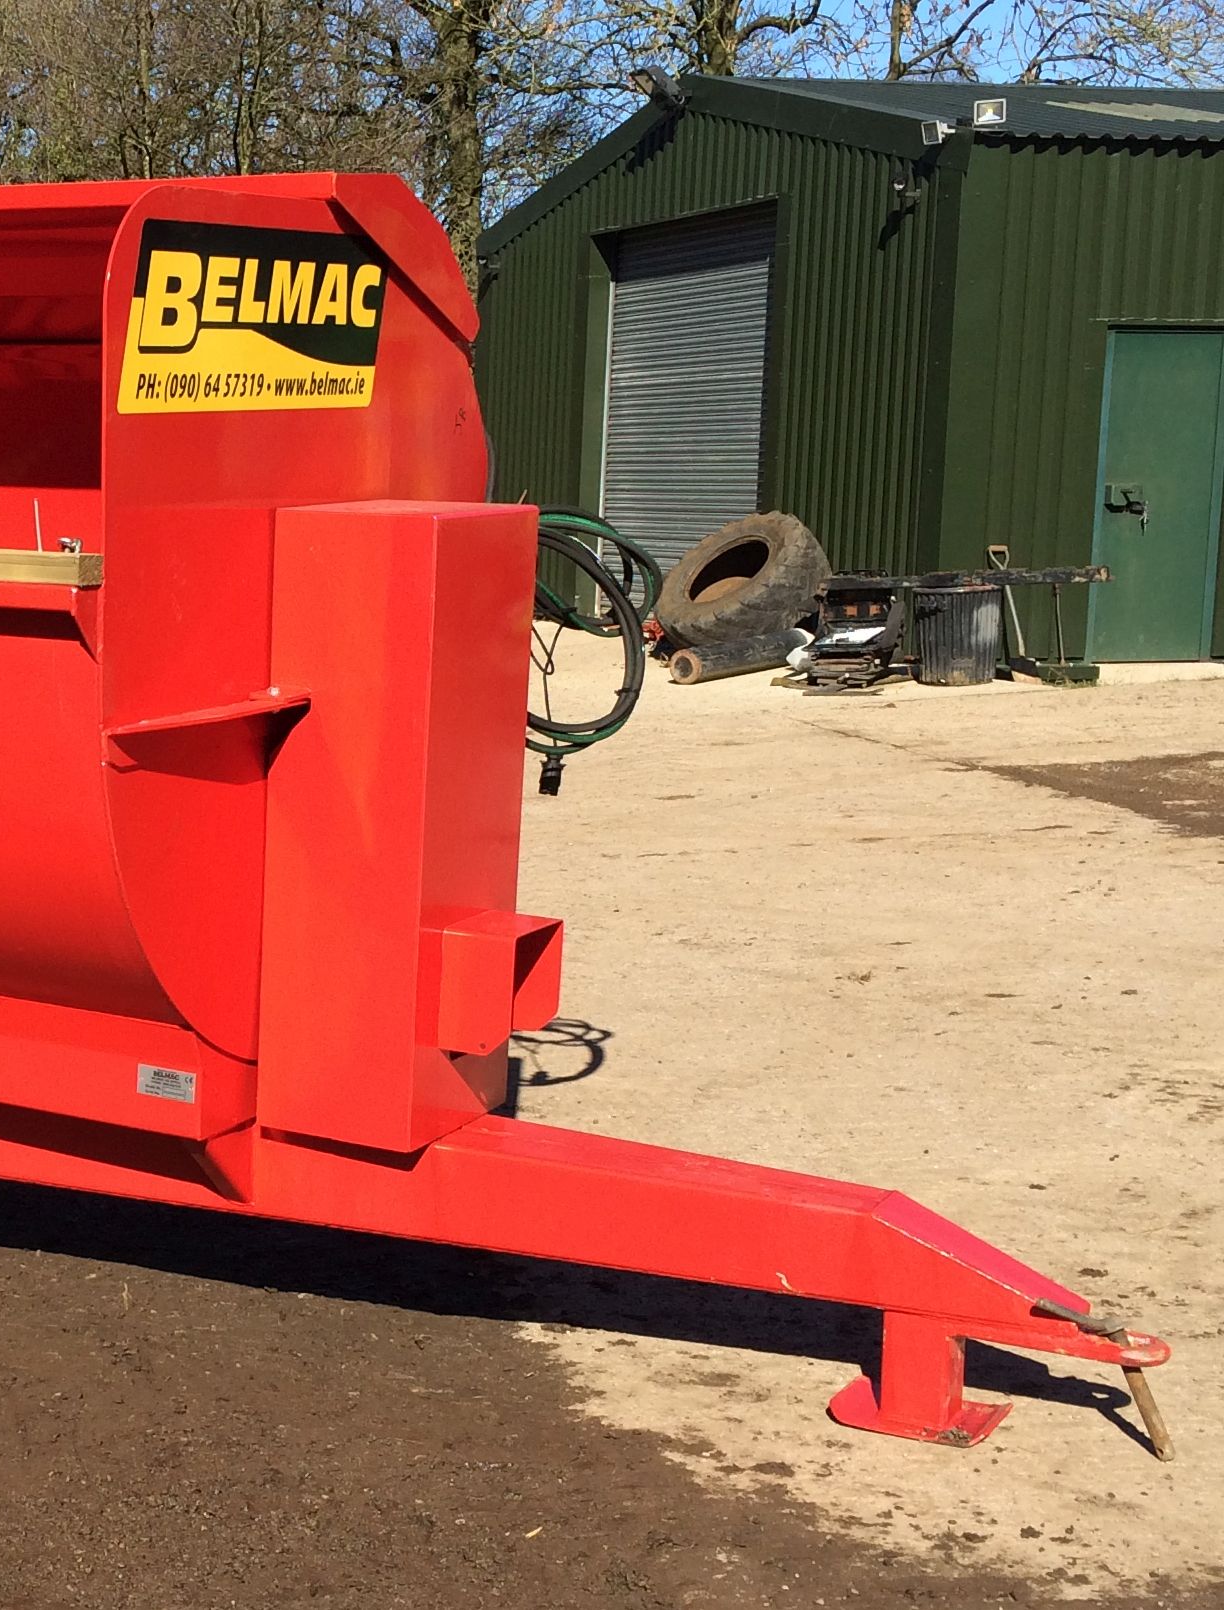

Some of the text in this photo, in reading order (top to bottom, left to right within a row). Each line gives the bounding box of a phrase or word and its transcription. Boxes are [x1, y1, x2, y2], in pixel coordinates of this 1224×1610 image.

[139, 250, 382, 347] BELMAC
[136, 373, 162, 399] PH:
[164, 372, 201, 403] (090)
[274, 371, 365, 396] www.belmac.ie
